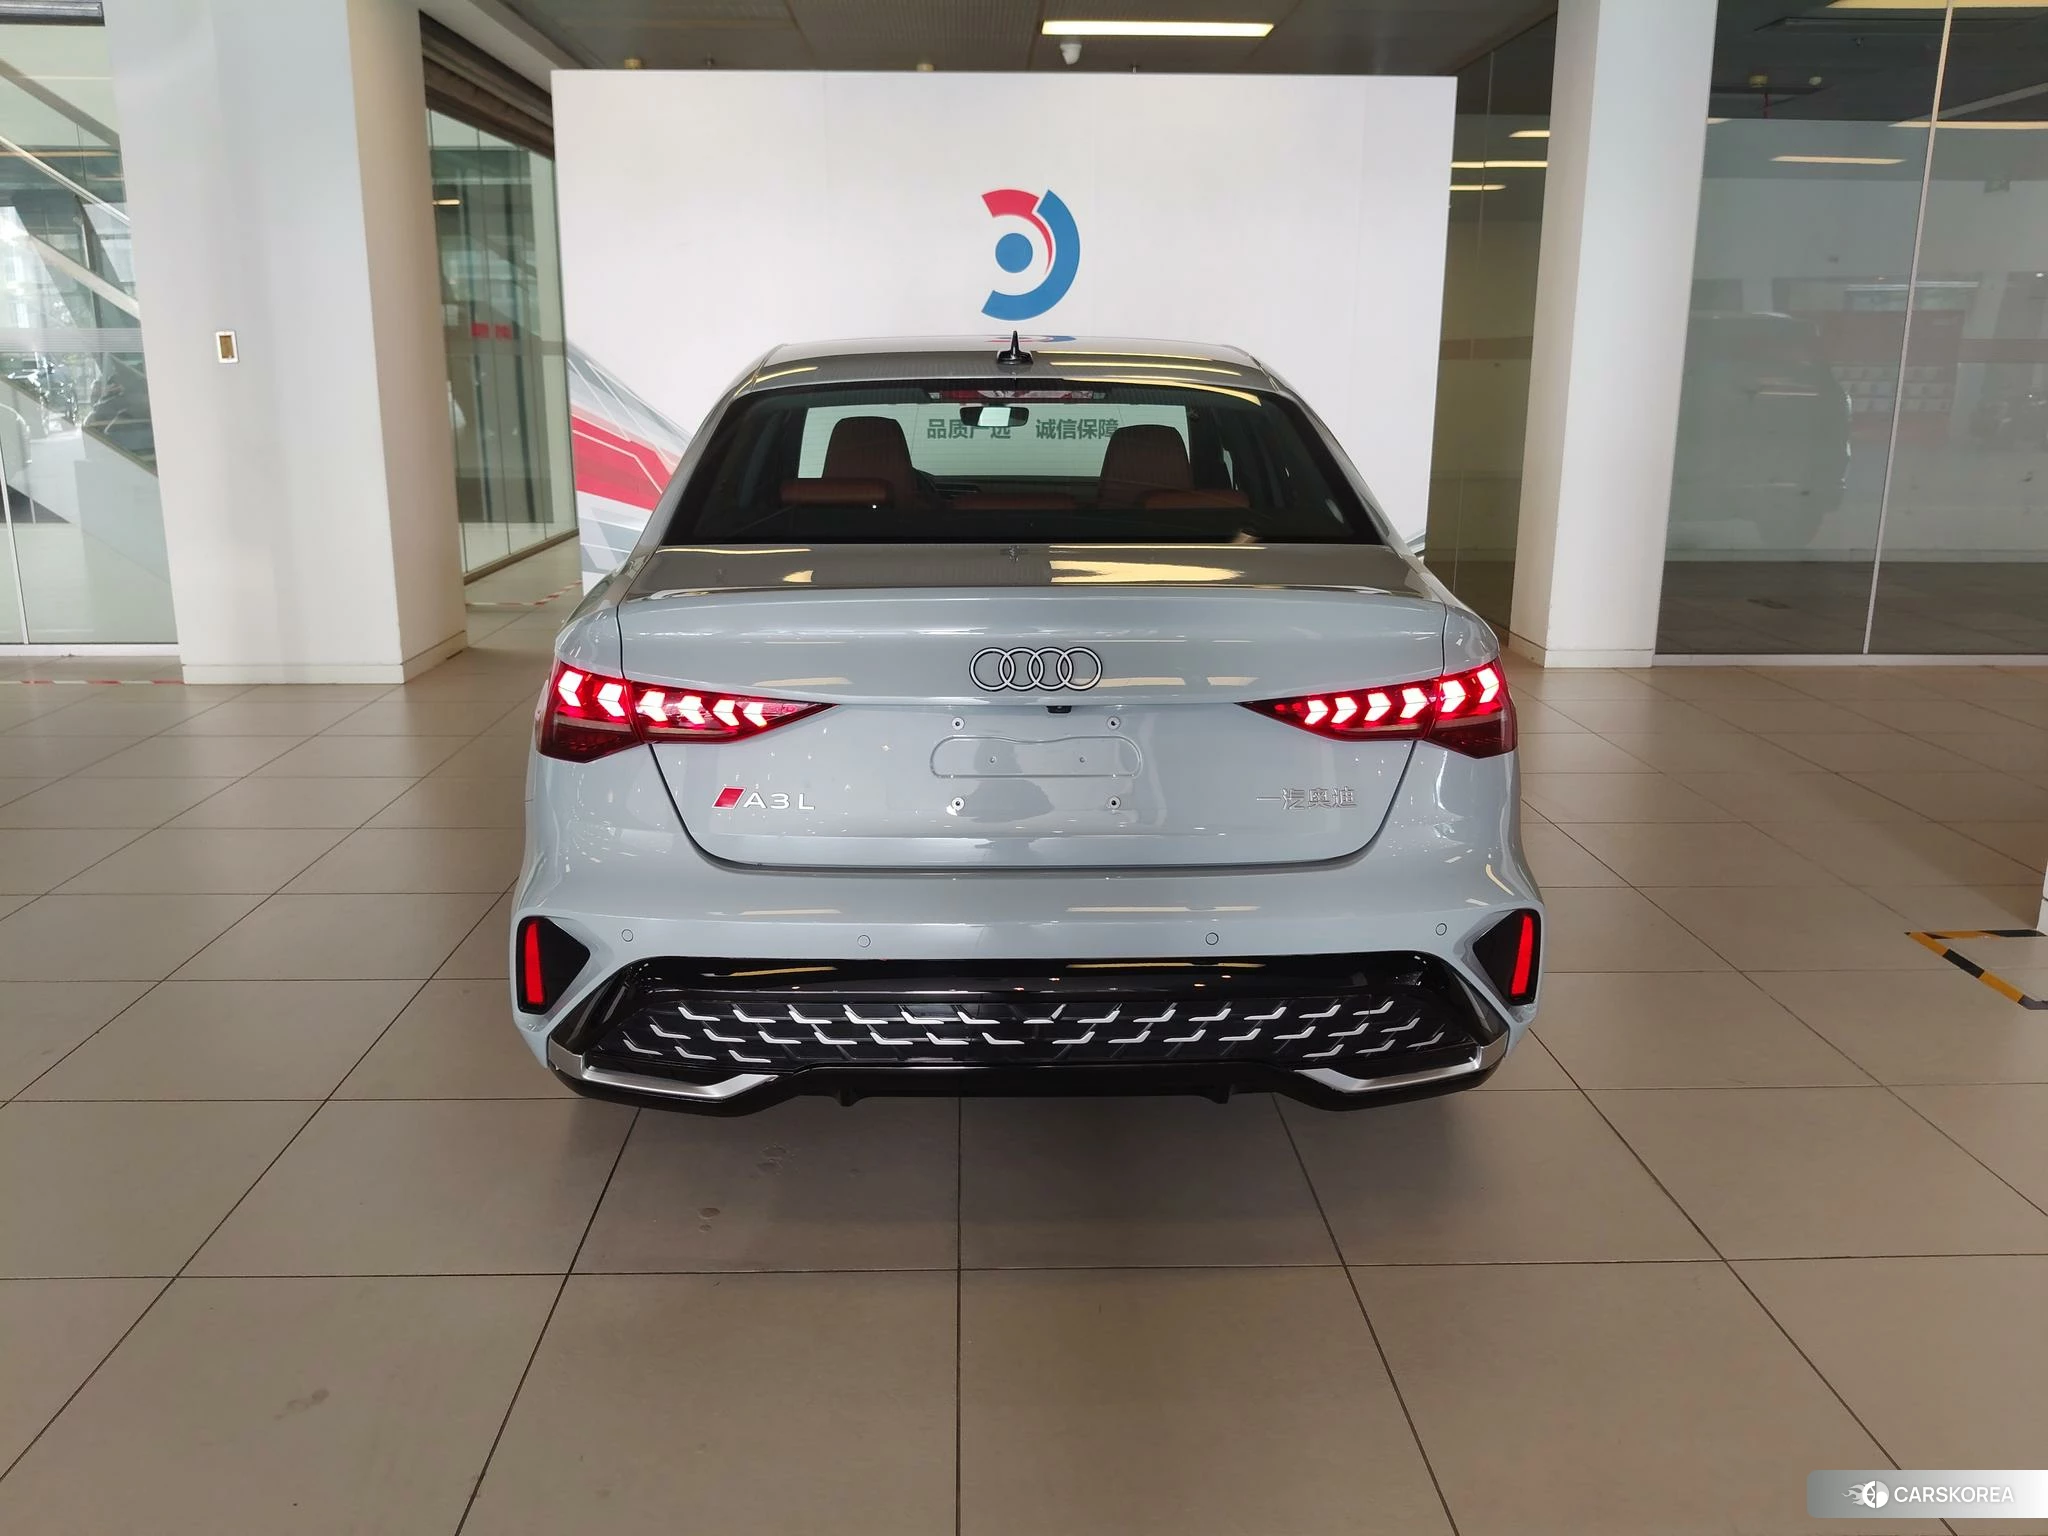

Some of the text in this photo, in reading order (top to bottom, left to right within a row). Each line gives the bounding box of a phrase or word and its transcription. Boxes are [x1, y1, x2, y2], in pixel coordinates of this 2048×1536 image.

[1036, 418, 1119, 439] 诚信保障
[1256, 786, 1357, 810] 一汽奥迪
